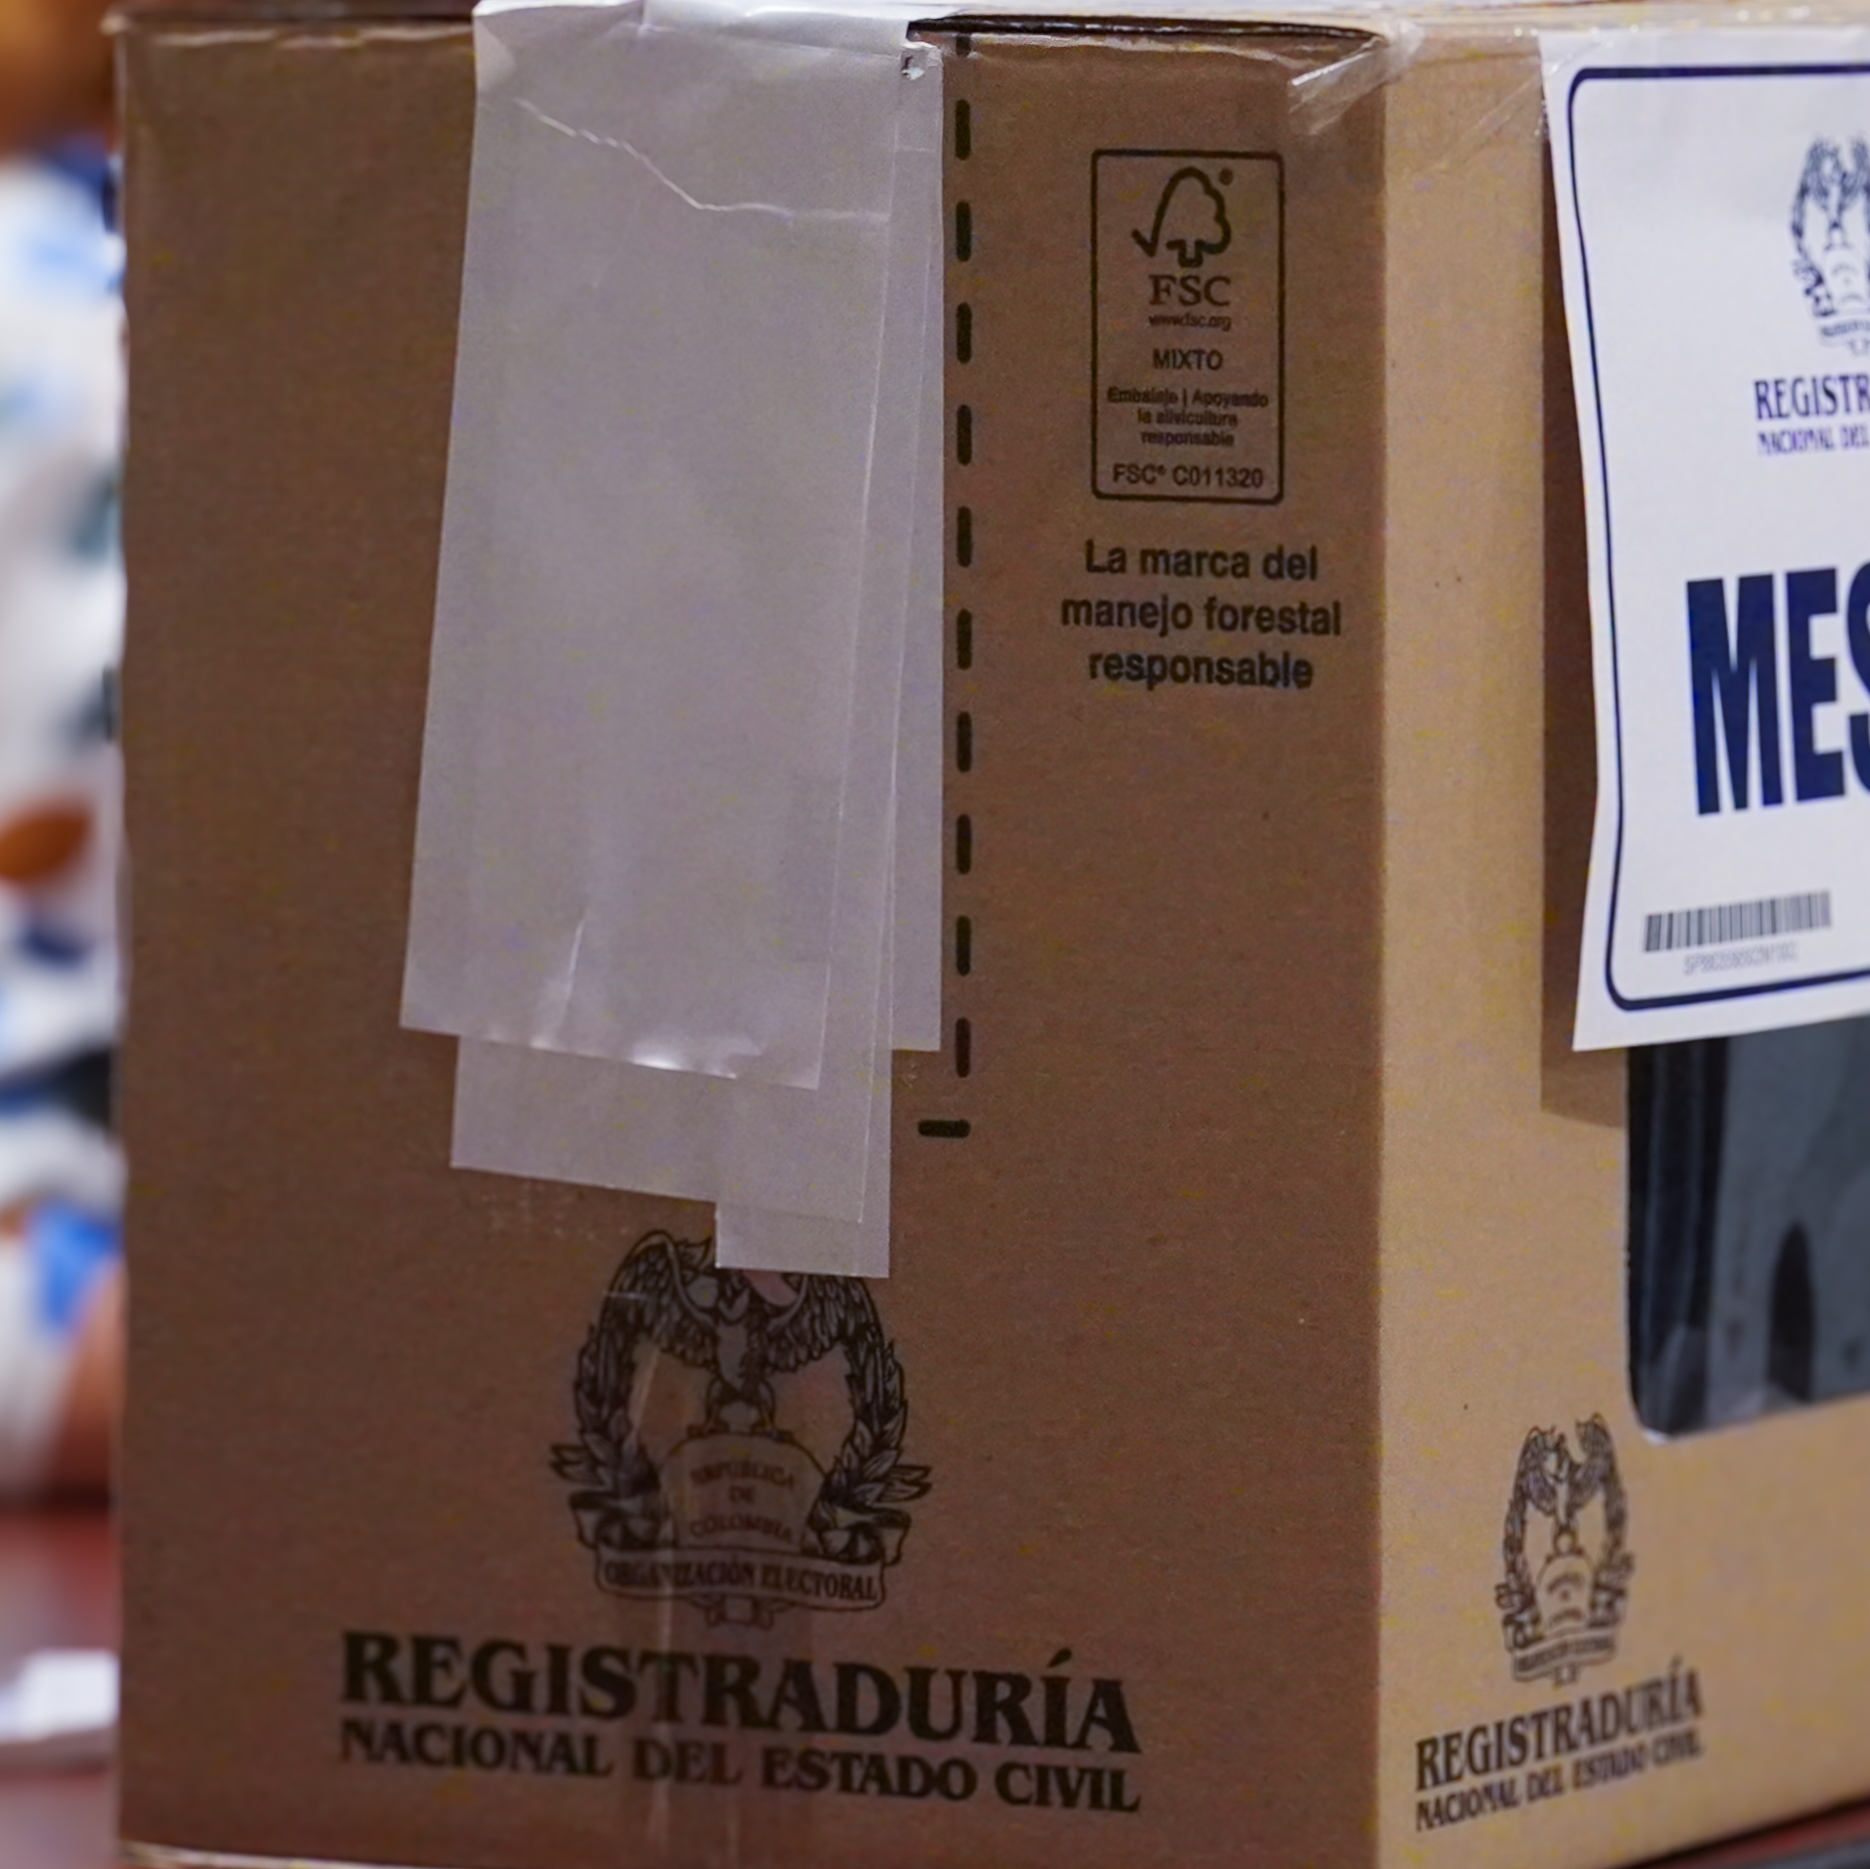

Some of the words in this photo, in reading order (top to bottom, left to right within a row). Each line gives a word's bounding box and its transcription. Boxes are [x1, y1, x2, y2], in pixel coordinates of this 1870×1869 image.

[1149, 274, 1231, 306] FSC
[1153, 348, 1224, 370] MIXTO
[1107, 386, 1179, 408] Embalaje
[1192, 388, 1269, 409] Apoyando
[1141, 431, 1235, 448] responsable
[1172, 465, 1264, 488] C011320
[1086, 539, 1127, 573] La
[1139, 547, 1249, 578] marca
[1262, 544, 1318, 580] del
[1061, 594, 1193, 638] manejo
[1203, 595, 1341, 636] forestal
[1089, 650, 1314, 691] responsable
[604, 1554, 756, 1589] ORGANIZACIÓN
[761, 1563, 879, 1601] ELECTORAL
[341, 1630, 1142, 1754] REGISTRADURÍA
[1415, 1653, 1704, 1792] REGISTRADURÍA
[340, 1717, 614, 1779] NACIONAL
[632, 1737, 743, 1786] DEL
[761, 1746, 978, 1801] ESTADO
[995, 1761, 1142, 1813] CIVIL
[1415, 1775, 1521, 1832] NACIONAL
[1527, 1763, 1565, 1802] DEL
[1572, 1741, 1645, 1791] ESTADO
